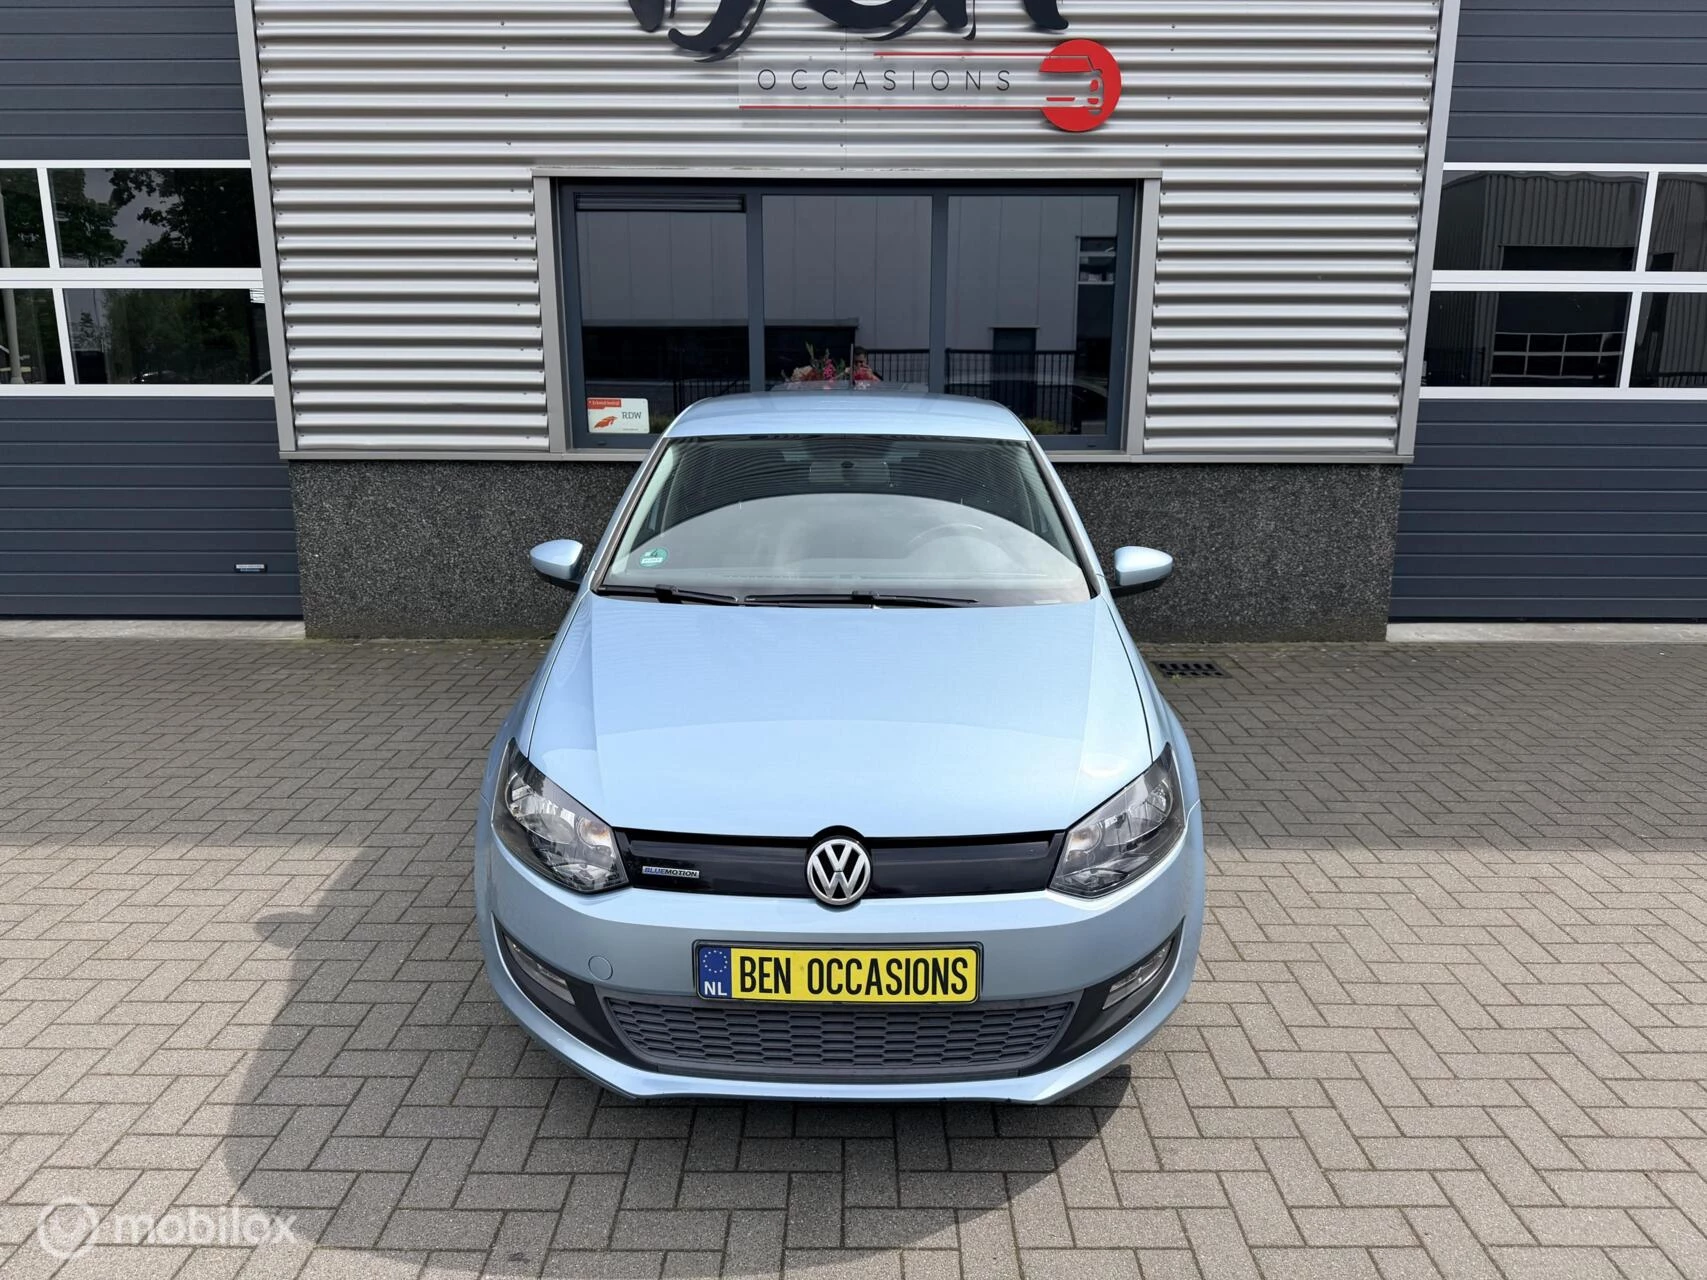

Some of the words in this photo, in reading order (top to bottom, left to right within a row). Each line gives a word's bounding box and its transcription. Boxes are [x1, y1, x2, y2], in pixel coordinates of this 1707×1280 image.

[757, 68, 1011, 92] OCCASIONS
[622, 411, 641, 420] RDW
[644, 867, 698, 877] BLUEMOTION
[739, 955, 792, 994] BEN
[807, 957, 968, 996] OCCASIONS
[704, 980, 728, 997] NL
